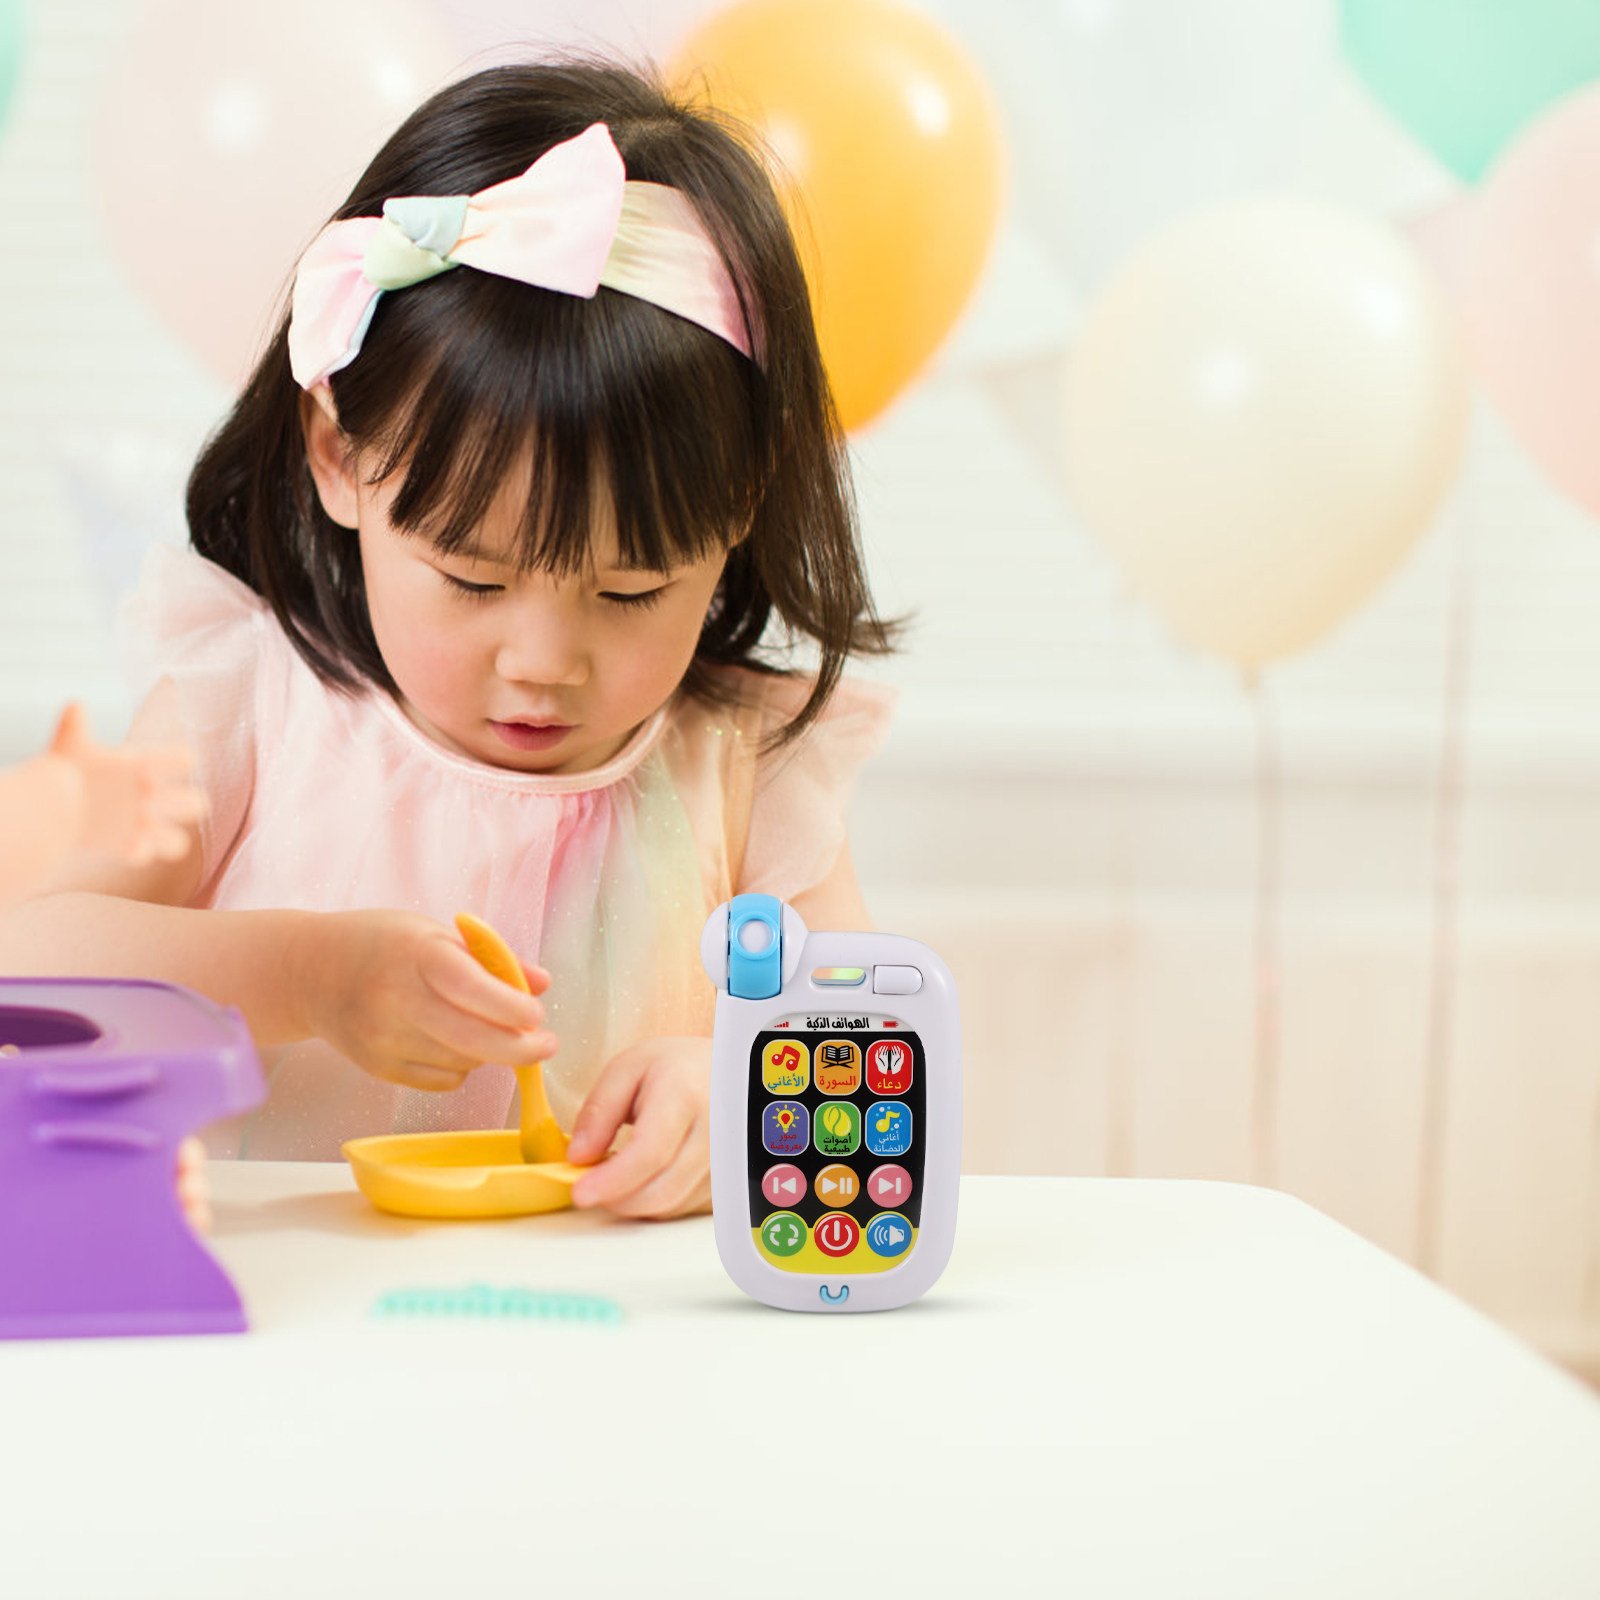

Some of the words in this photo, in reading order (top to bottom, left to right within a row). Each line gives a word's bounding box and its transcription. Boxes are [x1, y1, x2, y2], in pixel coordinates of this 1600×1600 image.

[806, 1017, 830, 1030] الذكية
[831, 1017, 869, 1030] الهواتف
[767, 1073, 804, 1090] الأغاني
[819, 1075, 856, 1089] السورة
[877, 1078, 902, 1089] دعاء
[779, 1133, 797, 1141] صور
[823, 1133, 852, 1144] أصوات
[878, 1131, 900, 1144] أغاني
[824, 1144, 851, 1155] طبيعية
[873, 1144, 904, 1152] الحضانة
